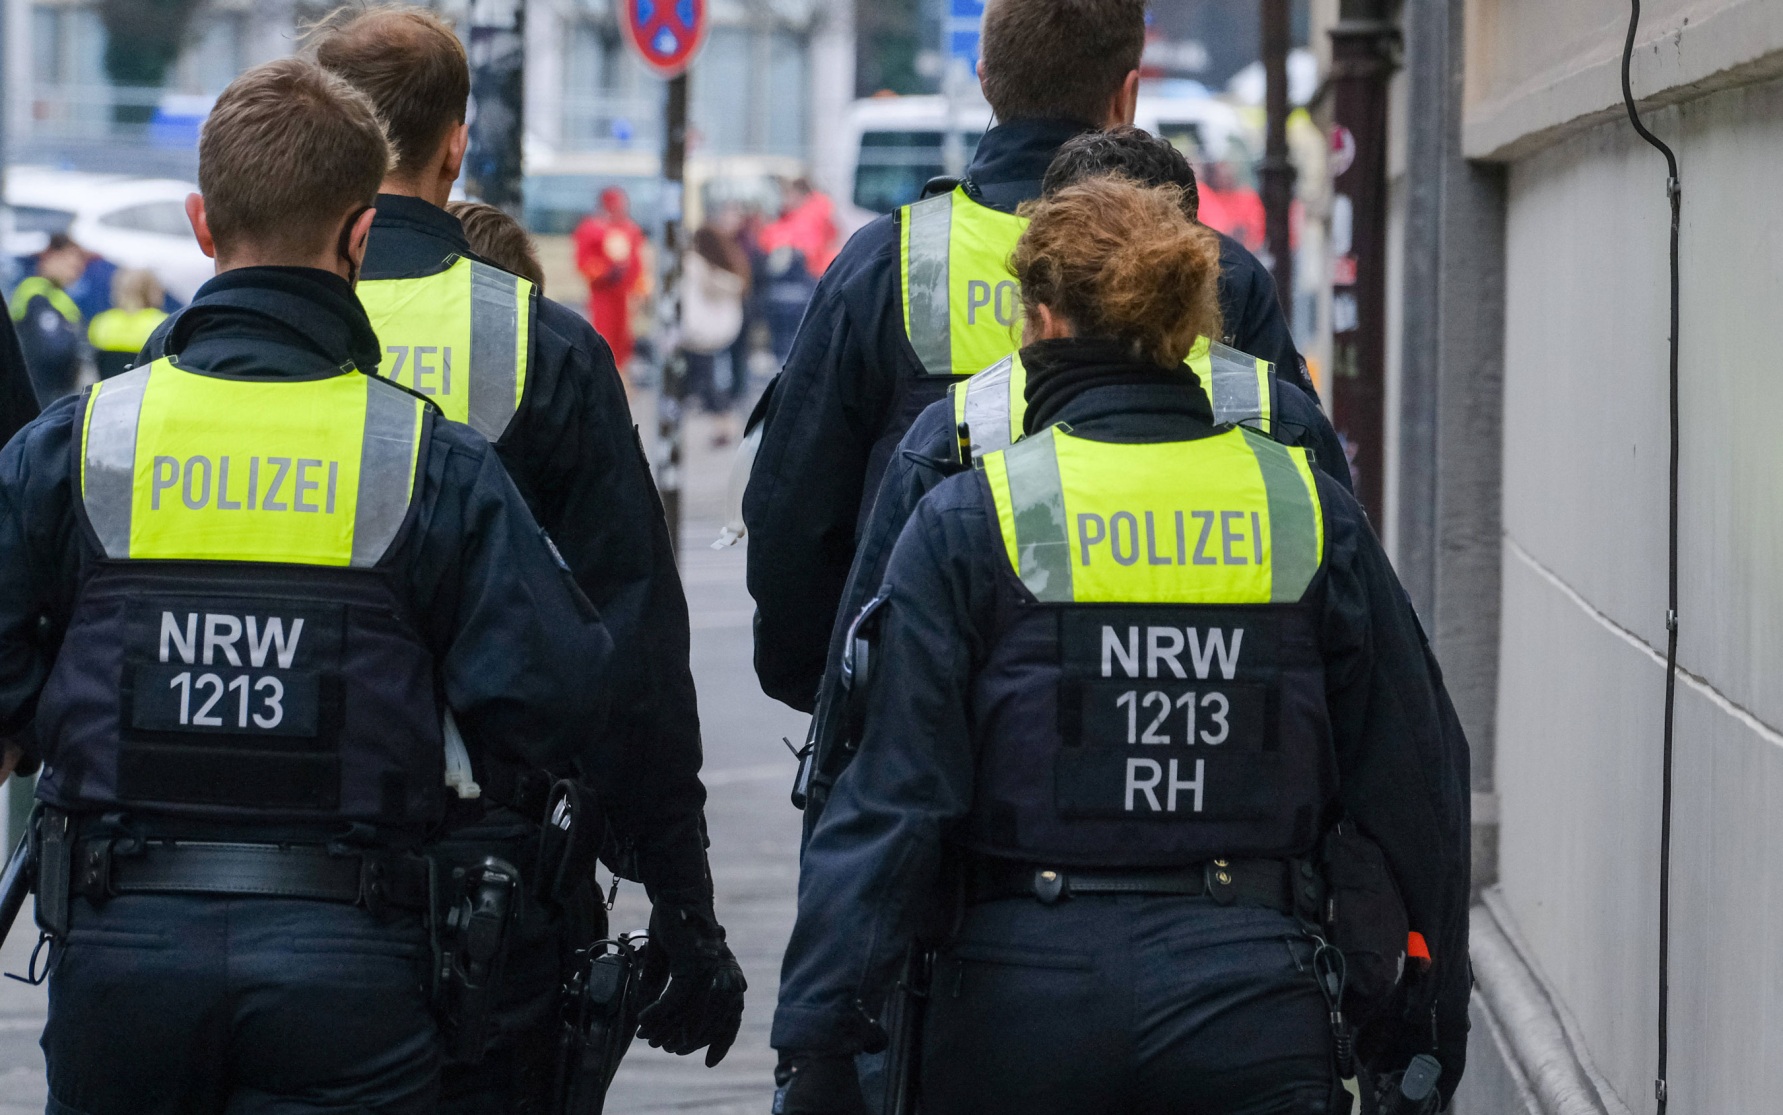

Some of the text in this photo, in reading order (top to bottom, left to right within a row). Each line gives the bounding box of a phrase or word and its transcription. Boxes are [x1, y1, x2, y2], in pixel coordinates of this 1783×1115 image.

[151, 455, 339, 514] POLIZEI
[1077, 511, 1263, 566] POLIZEI
[159, 611, 305, 669] NRW
[1102, 625, 1244, 680] NRW
[170, 672, 284, 729] 1213
[1116, 690, 1230, 745] 1213
[1125, 757, 1205, 812] RH
